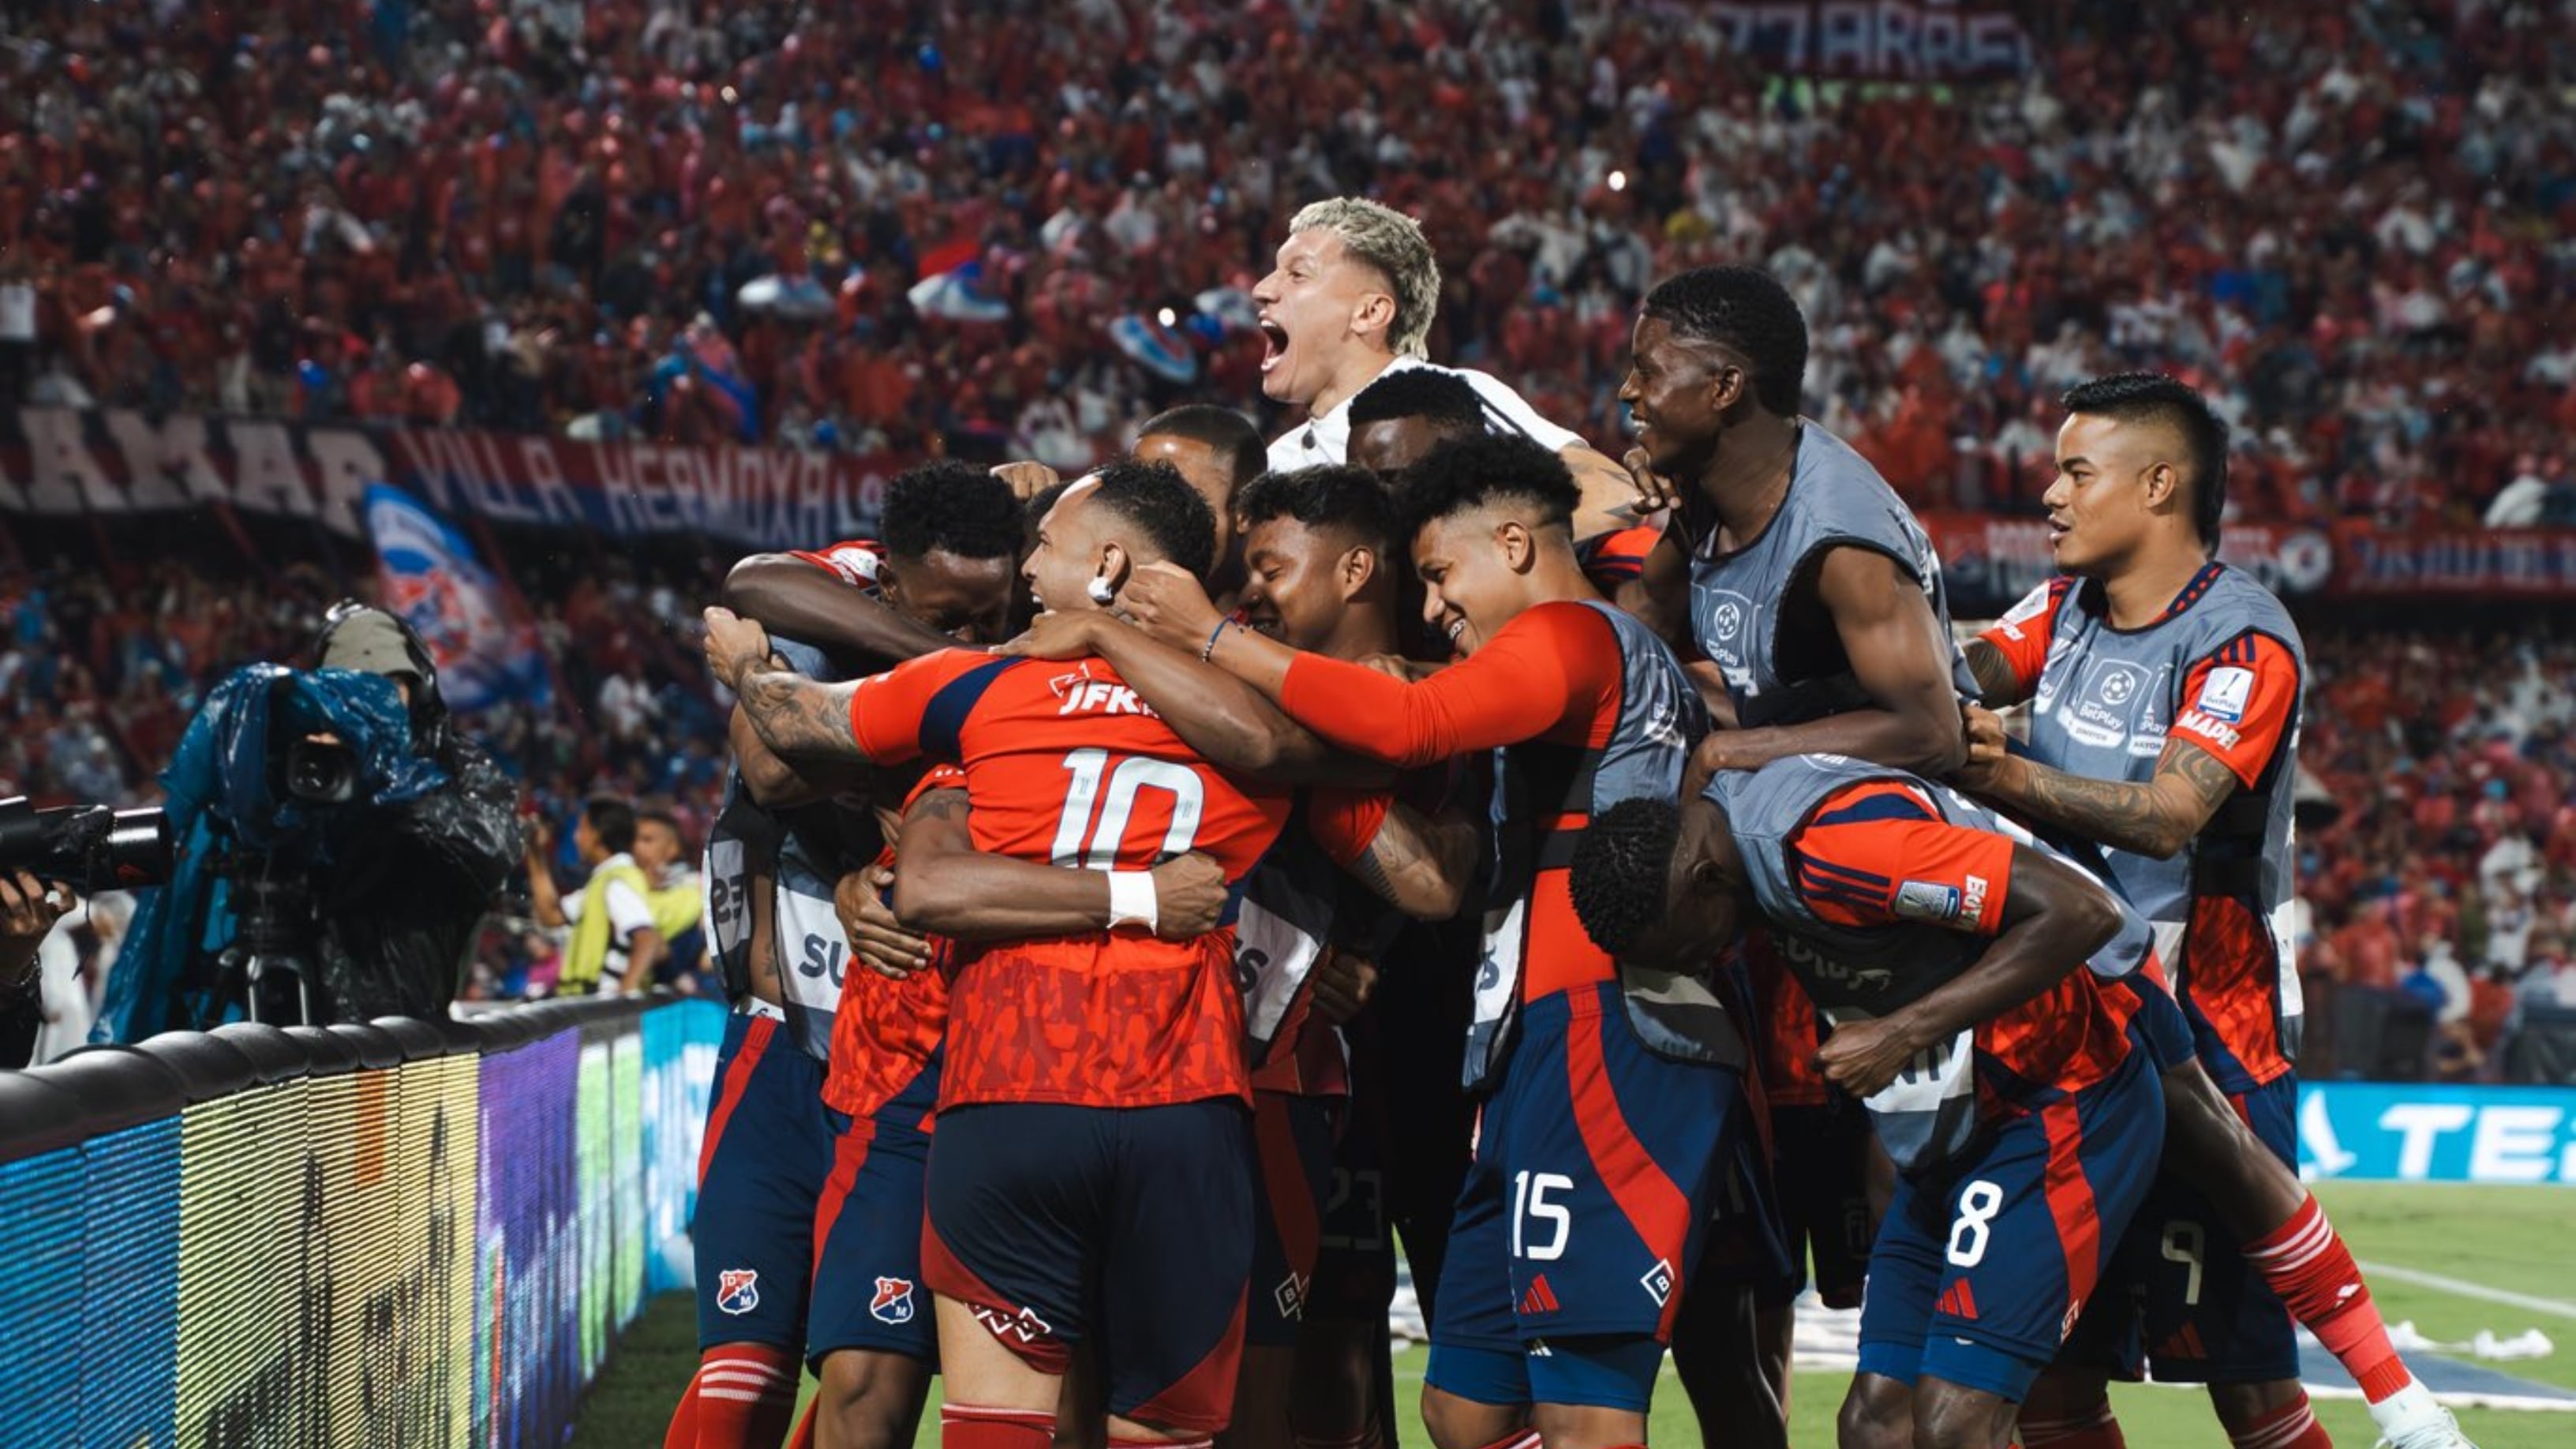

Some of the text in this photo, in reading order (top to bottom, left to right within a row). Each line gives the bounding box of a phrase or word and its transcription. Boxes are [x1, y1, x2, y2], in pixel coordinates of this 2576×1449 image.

[1051, 747, 1204, 870] 10
[2377, 1103, 2576, 1182] TE
[1513, 1170, 1574, 1260] 15
[1947, 1180, 2003, 1267] 8
[2162, 1220, 2205, 1305] 9
